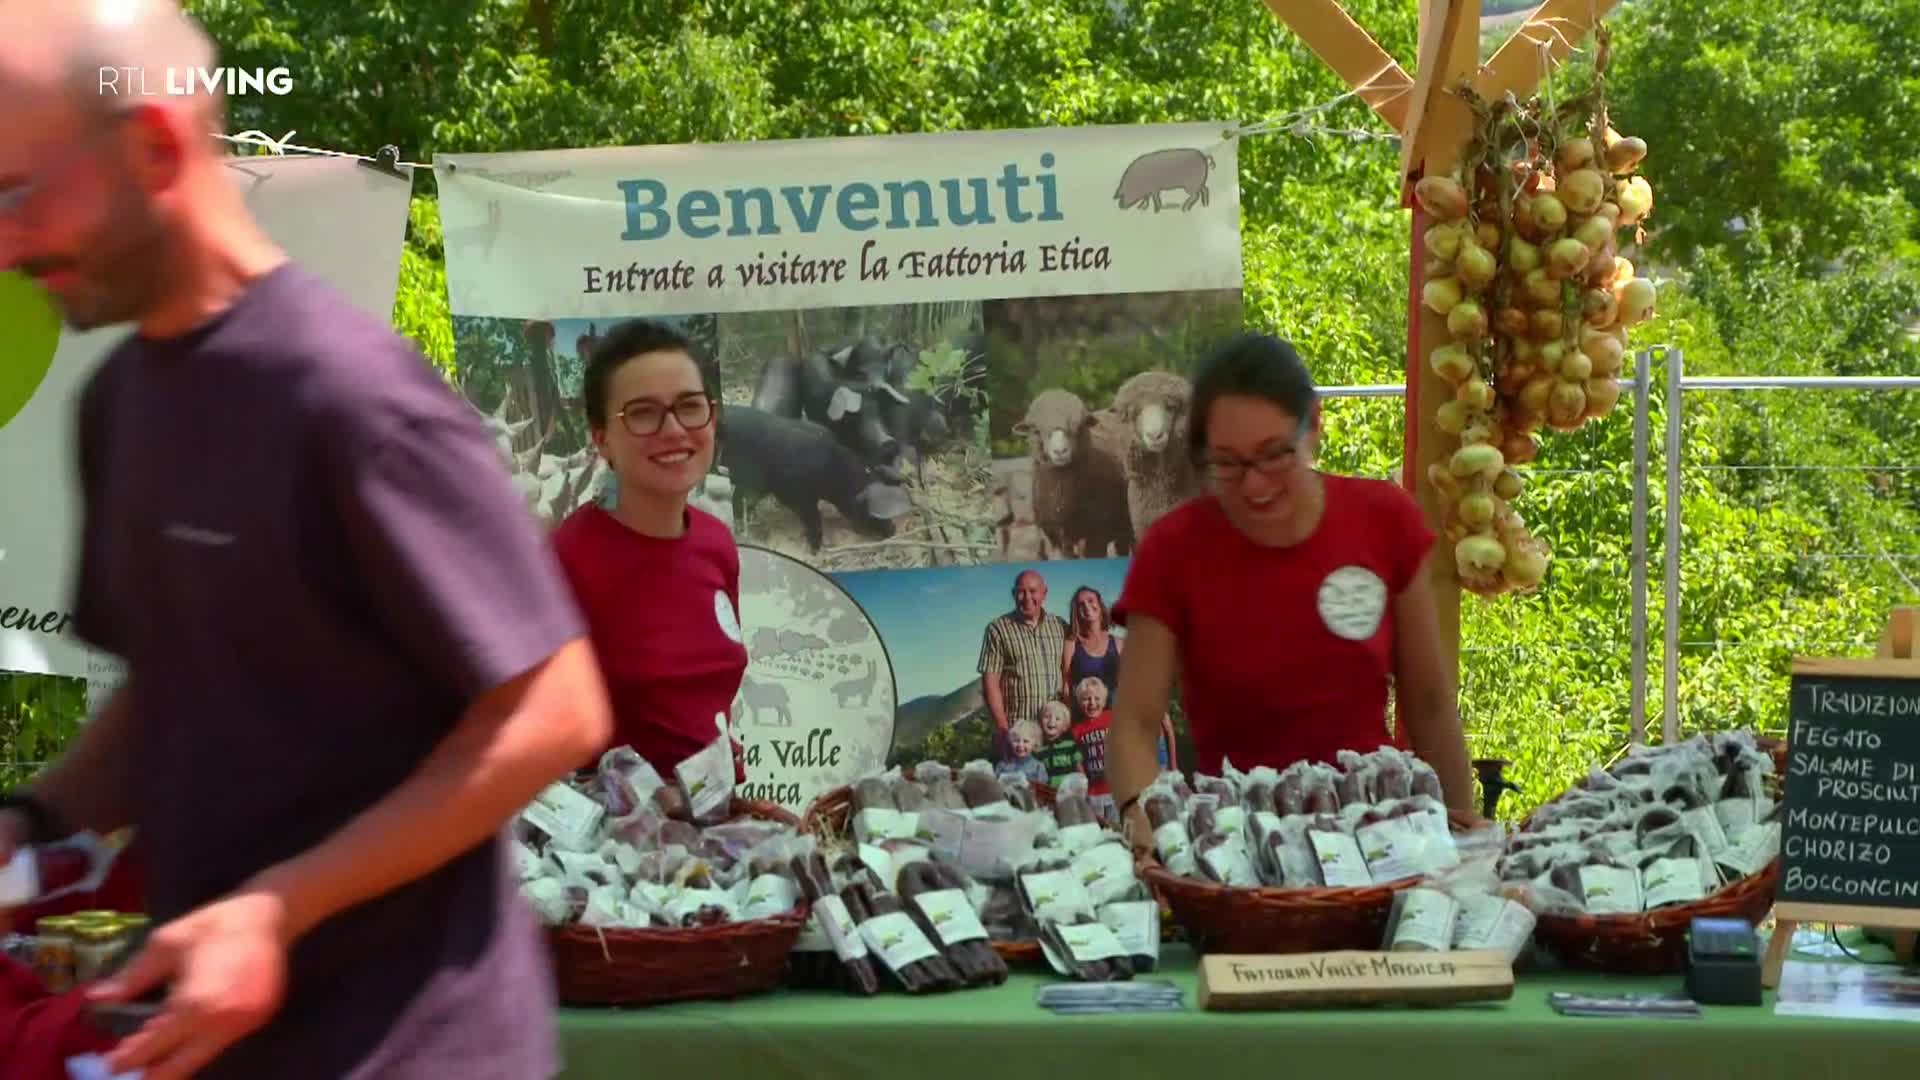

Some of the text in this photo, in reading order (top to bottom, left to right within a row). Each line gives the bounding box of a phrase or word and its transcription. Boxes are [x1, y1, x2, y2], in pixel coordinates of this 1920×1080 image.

[617, 153, 1064, 241] Benvenuti
[583, 236, 1112, 293] Entrate a visitare la Fattoria Etica
[1804, 685, 1920, 714] TRADIZION
[769, 728, 841, 768] Valle
[1794, 720, 1881, 750] FEGATO
[1790, 753, 1914, 781] SALAME DI
[1789, 807, 1920, 836] MONTEPULC
[1785, 836, 1891, 864] CHORIZO
[1785, 867, 1918, 896] BOCCONCIN
